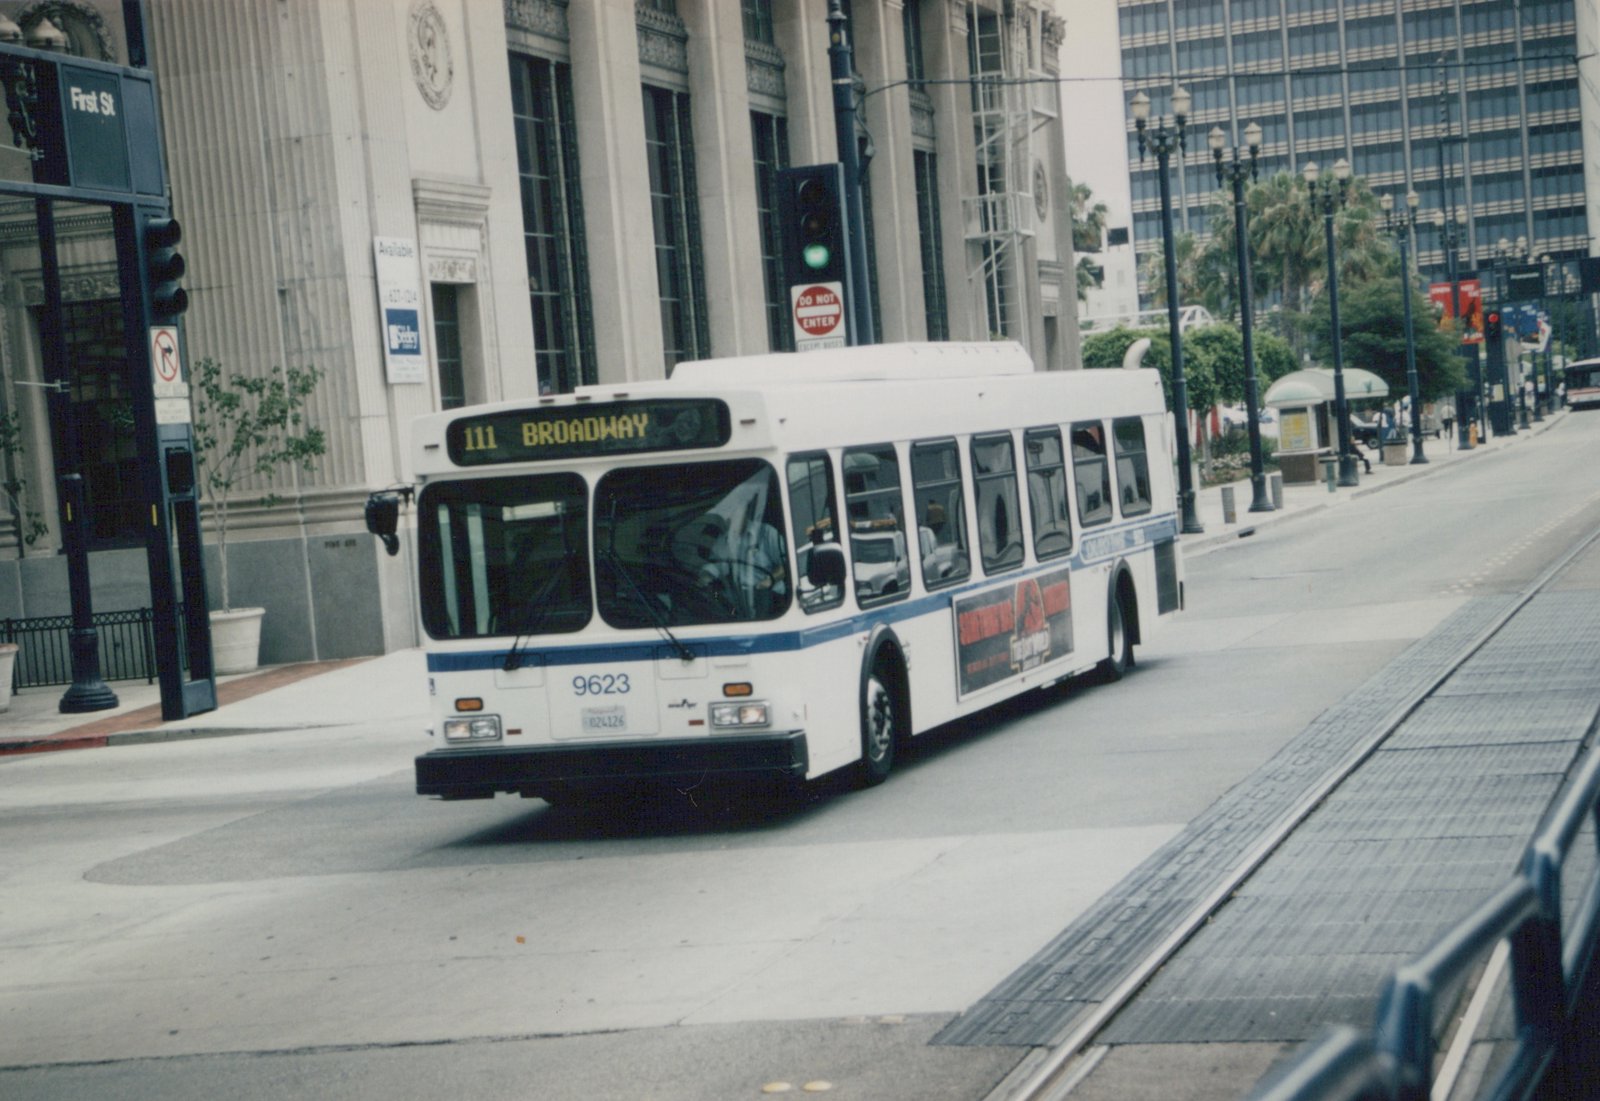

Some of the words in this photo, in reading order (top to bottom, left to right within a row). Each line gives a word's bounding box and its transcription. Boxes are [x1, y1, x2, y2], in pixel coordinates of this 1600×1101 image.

[70, 86, 99, 113] First
[100, 91, 116, 116] St
[379, 241, 413, 258] Available
[799, 295, 813, 306] DO
[816, 293, 835, 304] NOT
[803, 315, 835, 329] ENTER
[464, 425, 497, 450] 111
[522, 413, 649, 446] BROADWAY
[572, 673, 630, 696] 9623
